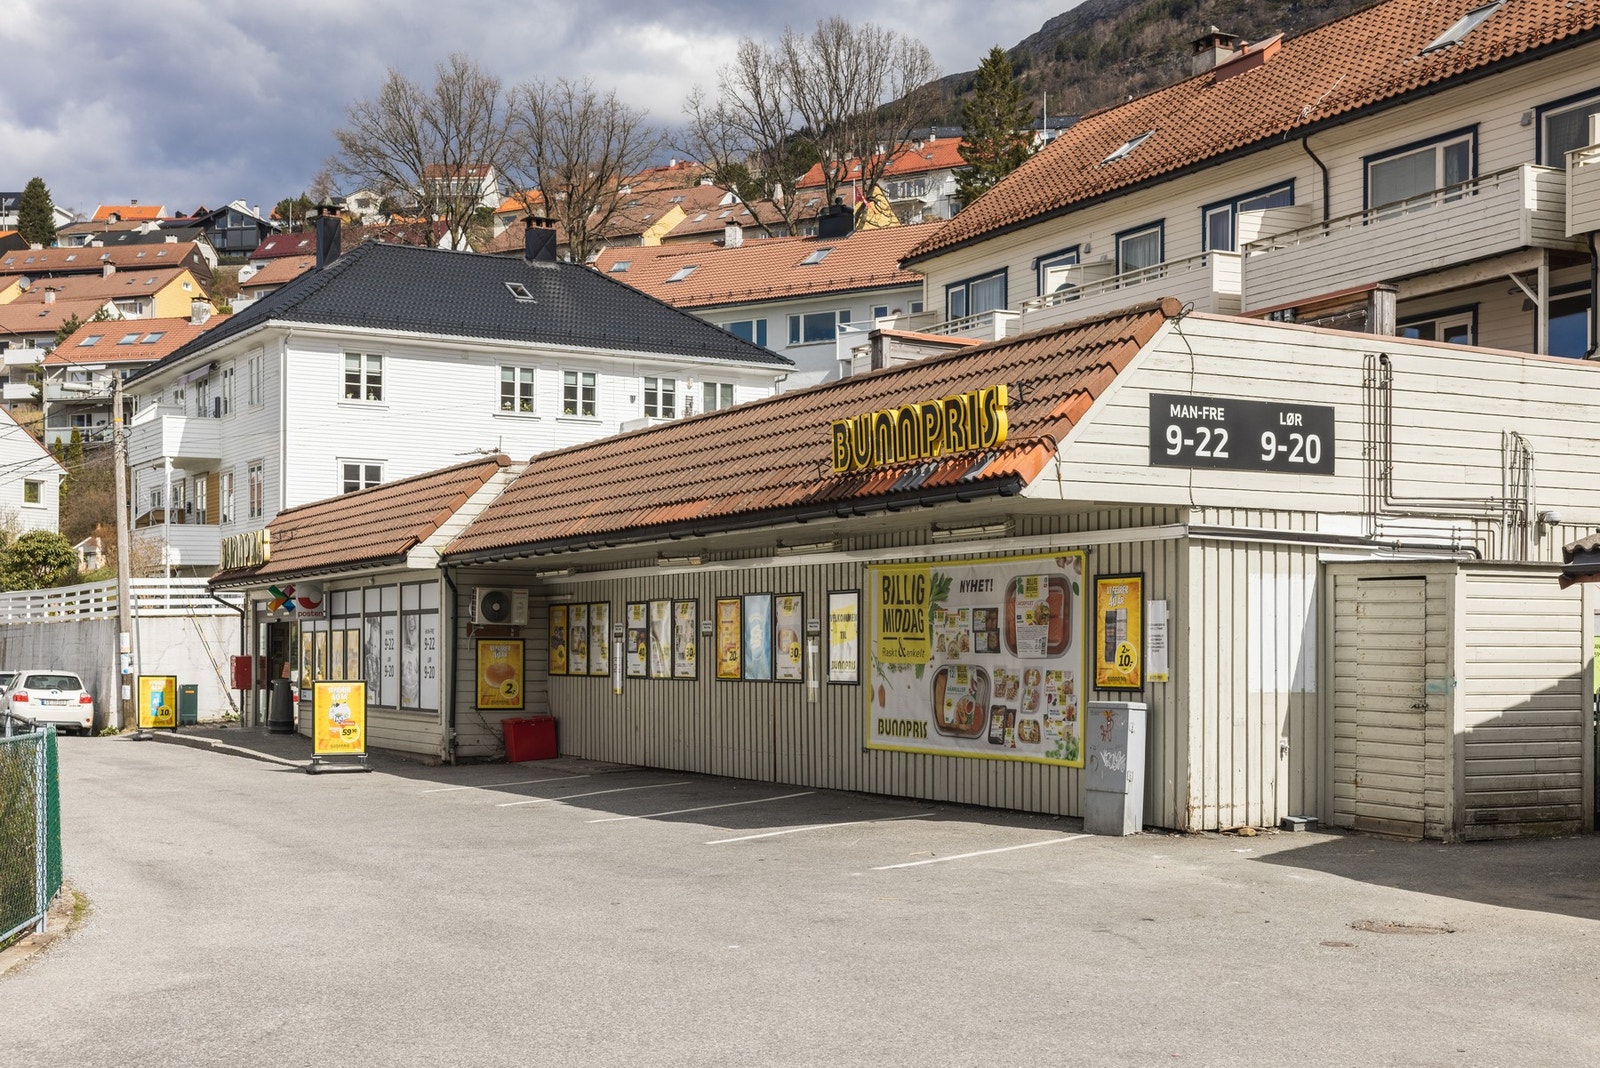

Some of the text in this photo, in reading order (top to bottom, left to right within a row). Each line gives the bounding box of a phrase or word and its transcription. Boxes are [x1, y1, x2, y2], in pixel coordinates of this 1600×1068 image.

[1170, 404, 1225, 421] MAN-FRE
[1279, 412, 1303, 427] LØR
[831, 384, 1008, 472] BUNNPRIS
[1166, 424, 1229, 459] 9-22
[1261, 431, 1322, 465] 9-20
[882, 574, 925, 605] BILLIG
[959, 578, 993, 593] NYHET!
[882, 608, 925, 634] MIDDAG
[384, 638, 395, 651] 9-22
[424, 637, 435, 651] 9-22
[882, 637, 925, 658] Raskt & enkelt
[384, 664, 395, 678] 9-20
[424, 665, 435, 679] 9-20
[878, 718, 928, 739] BUNNPRIS
